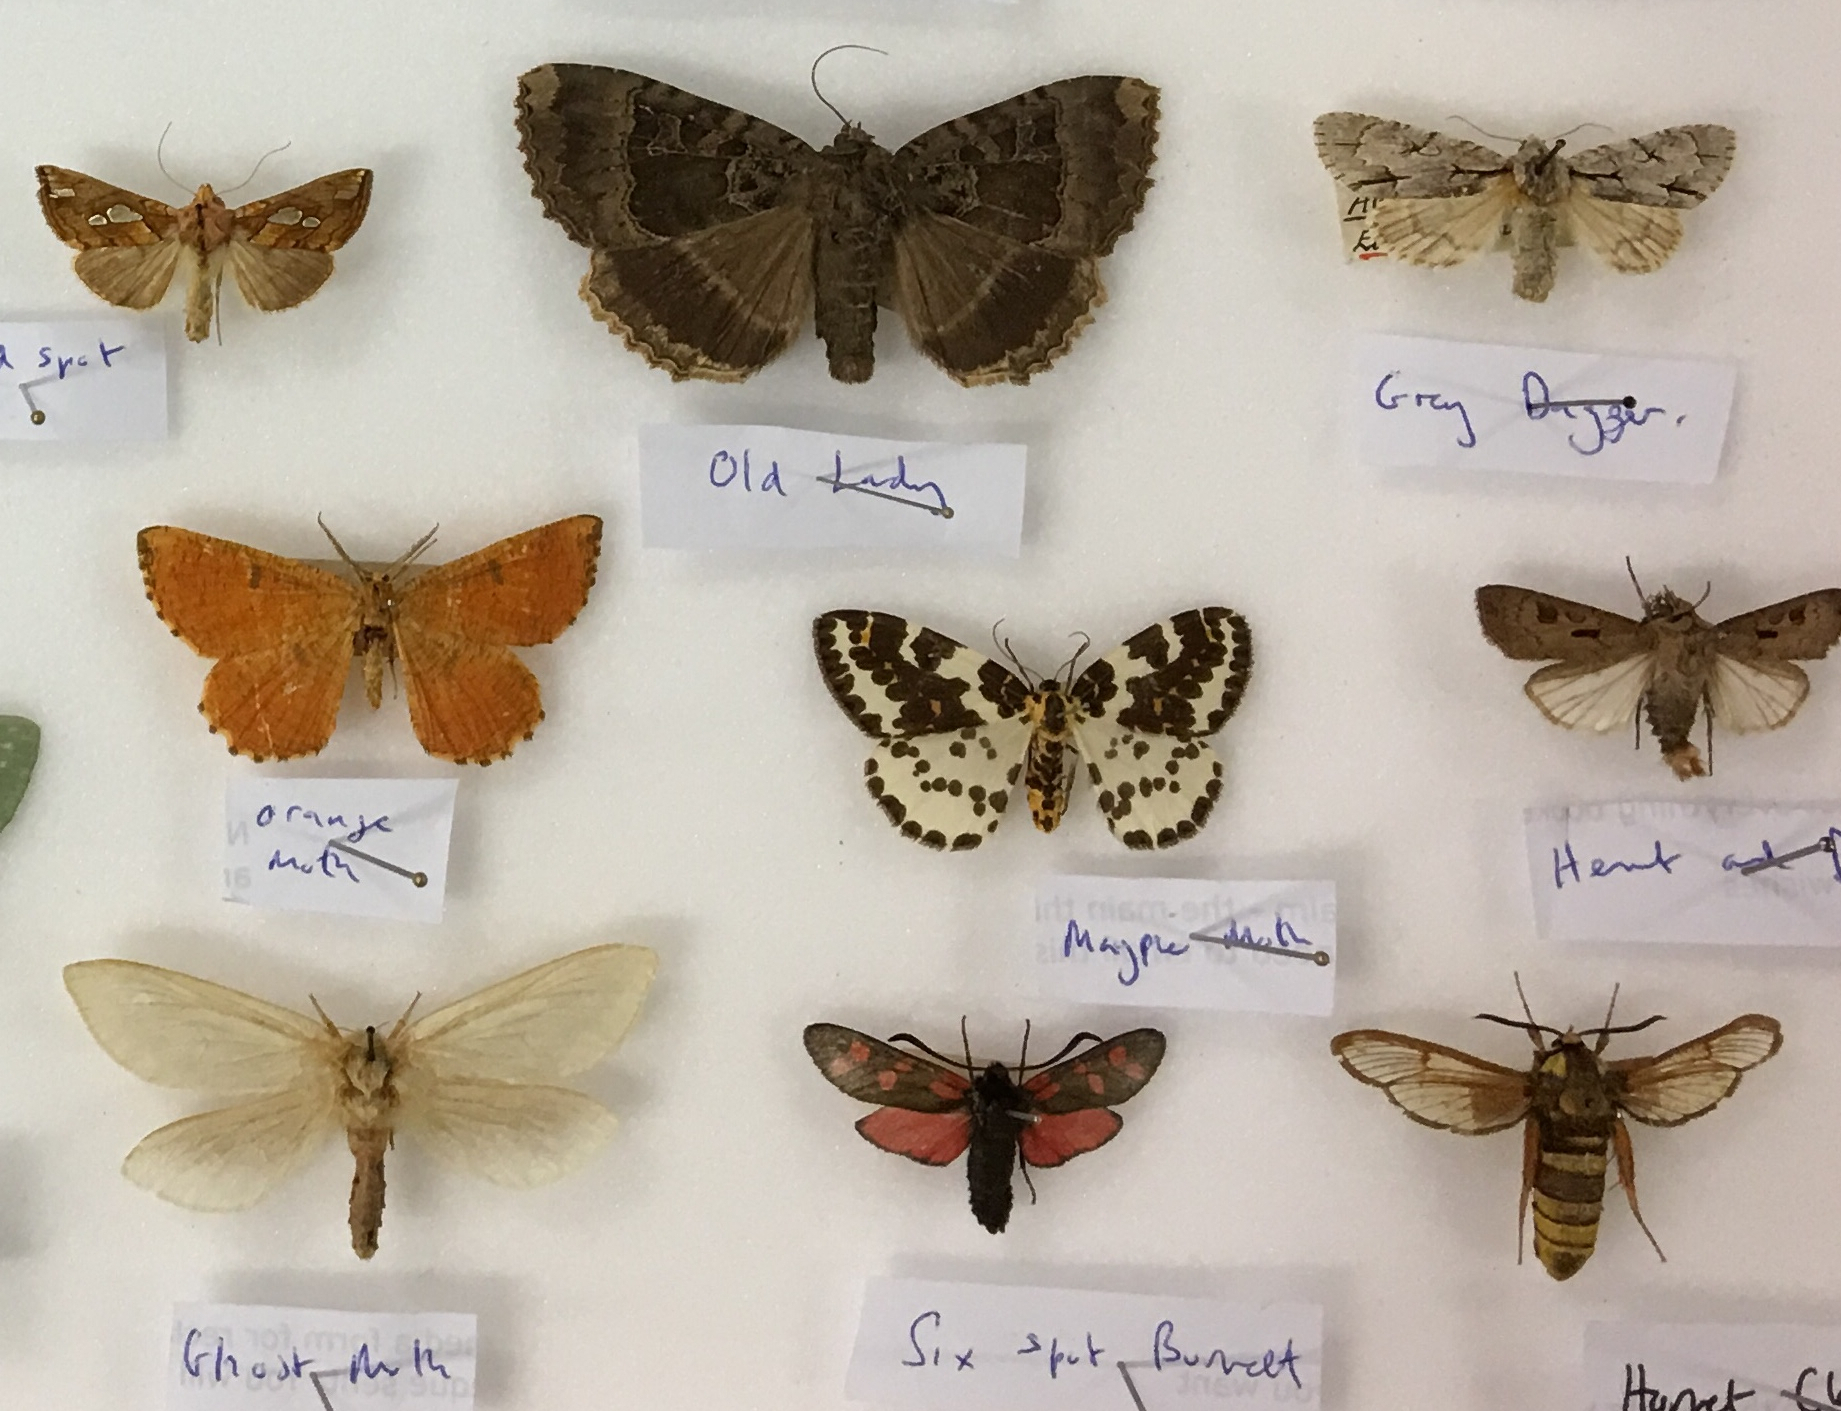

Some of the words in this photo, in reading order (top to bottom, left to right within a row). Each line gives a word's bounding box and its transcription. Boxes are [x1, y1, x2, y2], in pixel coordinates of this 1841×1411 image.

[709, 449, 787, 497] Old
[826, 451, 951, 514] Lady
[183, 1328, 317, 1384] Ghost
[901, 1311, 974, 1371] Six
